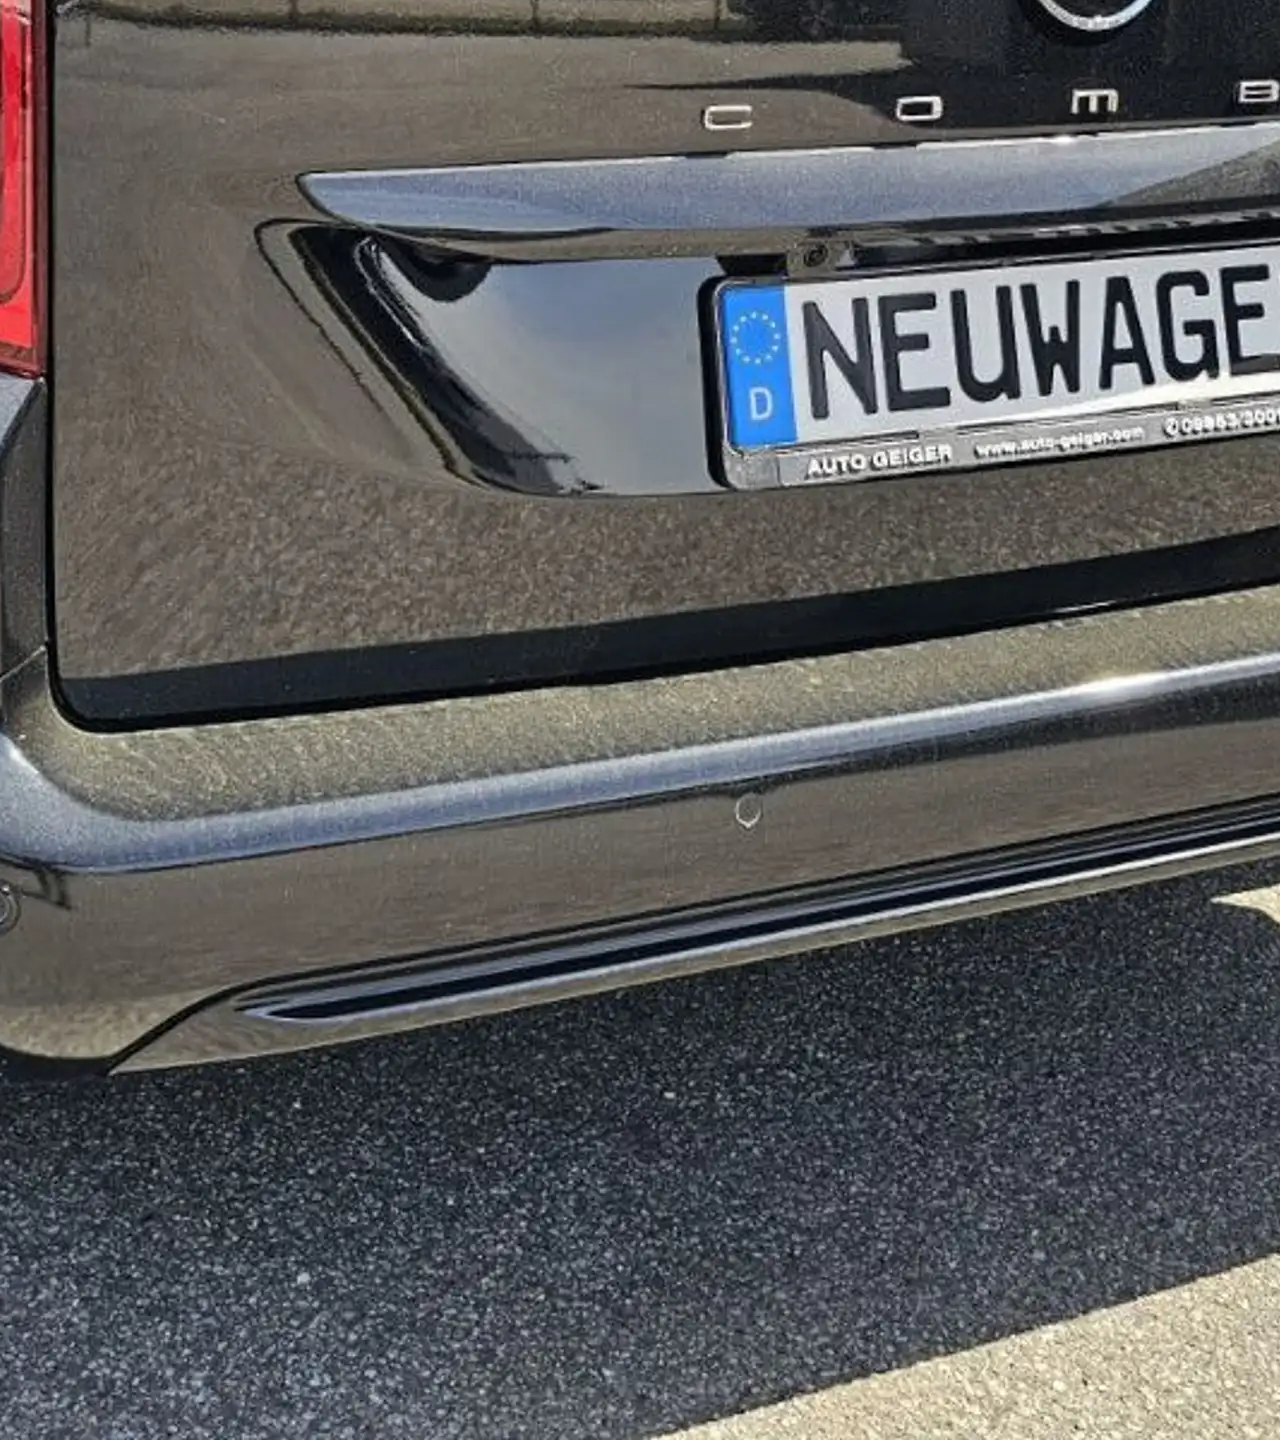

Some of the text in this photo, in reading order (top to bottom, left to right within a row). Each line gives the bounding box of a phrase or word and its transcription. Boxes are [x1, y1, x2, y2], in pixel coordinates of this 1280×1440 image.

[748, 386, 774, 422] D
[806, 453, 867, 480] AUTO
[872, 444, 953, 468] GEIGER
